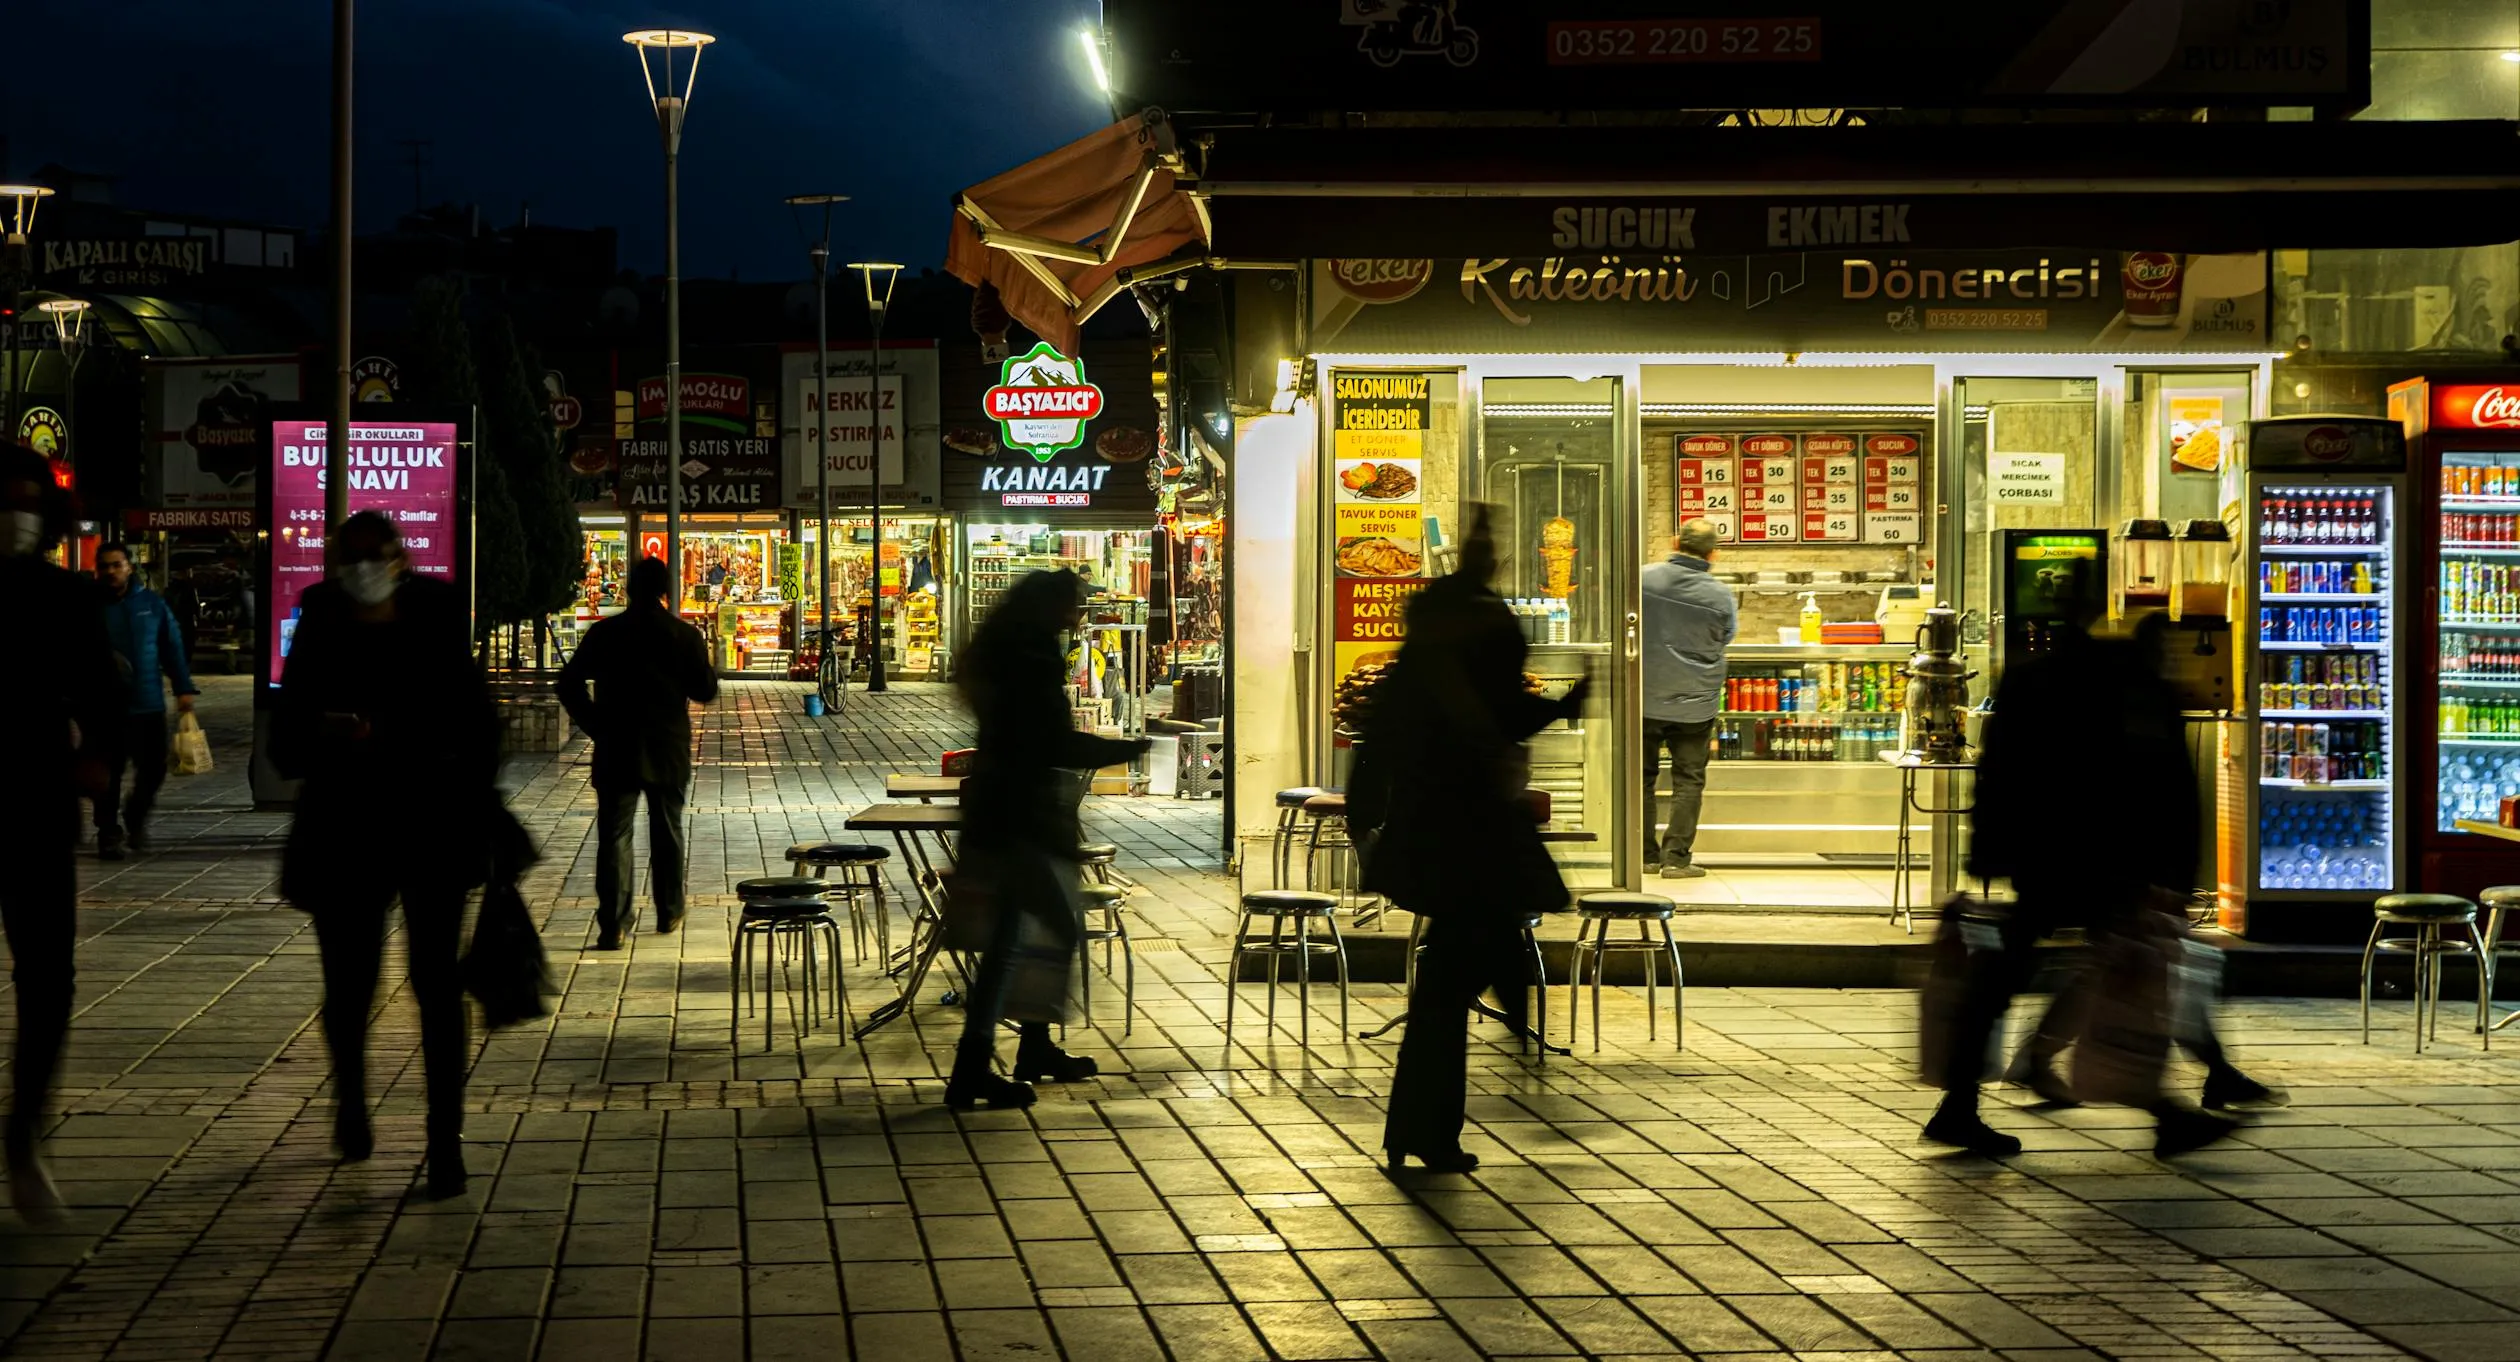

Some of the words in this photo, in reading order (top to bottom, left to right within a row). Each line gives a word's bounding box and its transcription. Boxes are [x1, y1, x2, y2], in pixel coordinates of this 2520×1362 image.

[1555, 30, 1635, 56] 0352
[1648, 27, 1708, 55] 220
[1721, 27, 1760, 54] 52
[1773, 26, 1812, 53] 25
[2184, 46, 2329, 76] BULMUŞ
[1552, 207, 1696, 250] SUCUK
[1767, 204, 1912, 248] EKMEK
[44, 240, 128, 274] KAPALI
[134, 240, 205, 276] ÇARŞI
[1460, 256, 1699, 327] Kaleönü
[1842, 257, 2100, 300] Dönercisi
[2193, 319, 2256, 333] BULMUŞ
[1336, 379, 1427, 399] SALONUMUZ
[996, 391, 1089, 415] BAŞYAZICI
[365, 430, 419, 440] OKULLARI
[1351, 436, 1361, 444] ET
[688, 440, 729, 458] SATIŞ
[1878, 441, 1905, 450] SUCUK
[1683, 469, 1695, 478] TEK
[1705, 469, 1725, 481] 16
[1745, 468, 1758, 478] TEK
[1768, 467, 1784, 476] 30
[1807, 468, 1819, 477] TEK
[1830, 466, 1846, 476] 25
[1868, 468, 1881, 477] TEK
[1891, 466, 1907, 476] 30
[2001, 473, 2051, 481] MERCİMEK
[317, 469, 408, 490] SNAVI
[982, 465, 1111, 491] KANAAT
[707, 484, 761, 504] KALE
[1769, 494, 1785, 503] 40
[1831, 494, 1846, 503] 35
[1893, 493, 1909, 502] 50
[1999, 488, 2053, 498] ÇORBASI
[1006, 495, 1049, 505] PASTIRMA
[1056, 495, 1087, 505] SUCUK
[1708, 496, 1728, 508] 24
[1341, 510, 1375, 519] TAVUK
[1769, 524, 1789, 536] 50
[1830, 521, 1846, 530] 45
[1884, 530, 1900, 539] 60
